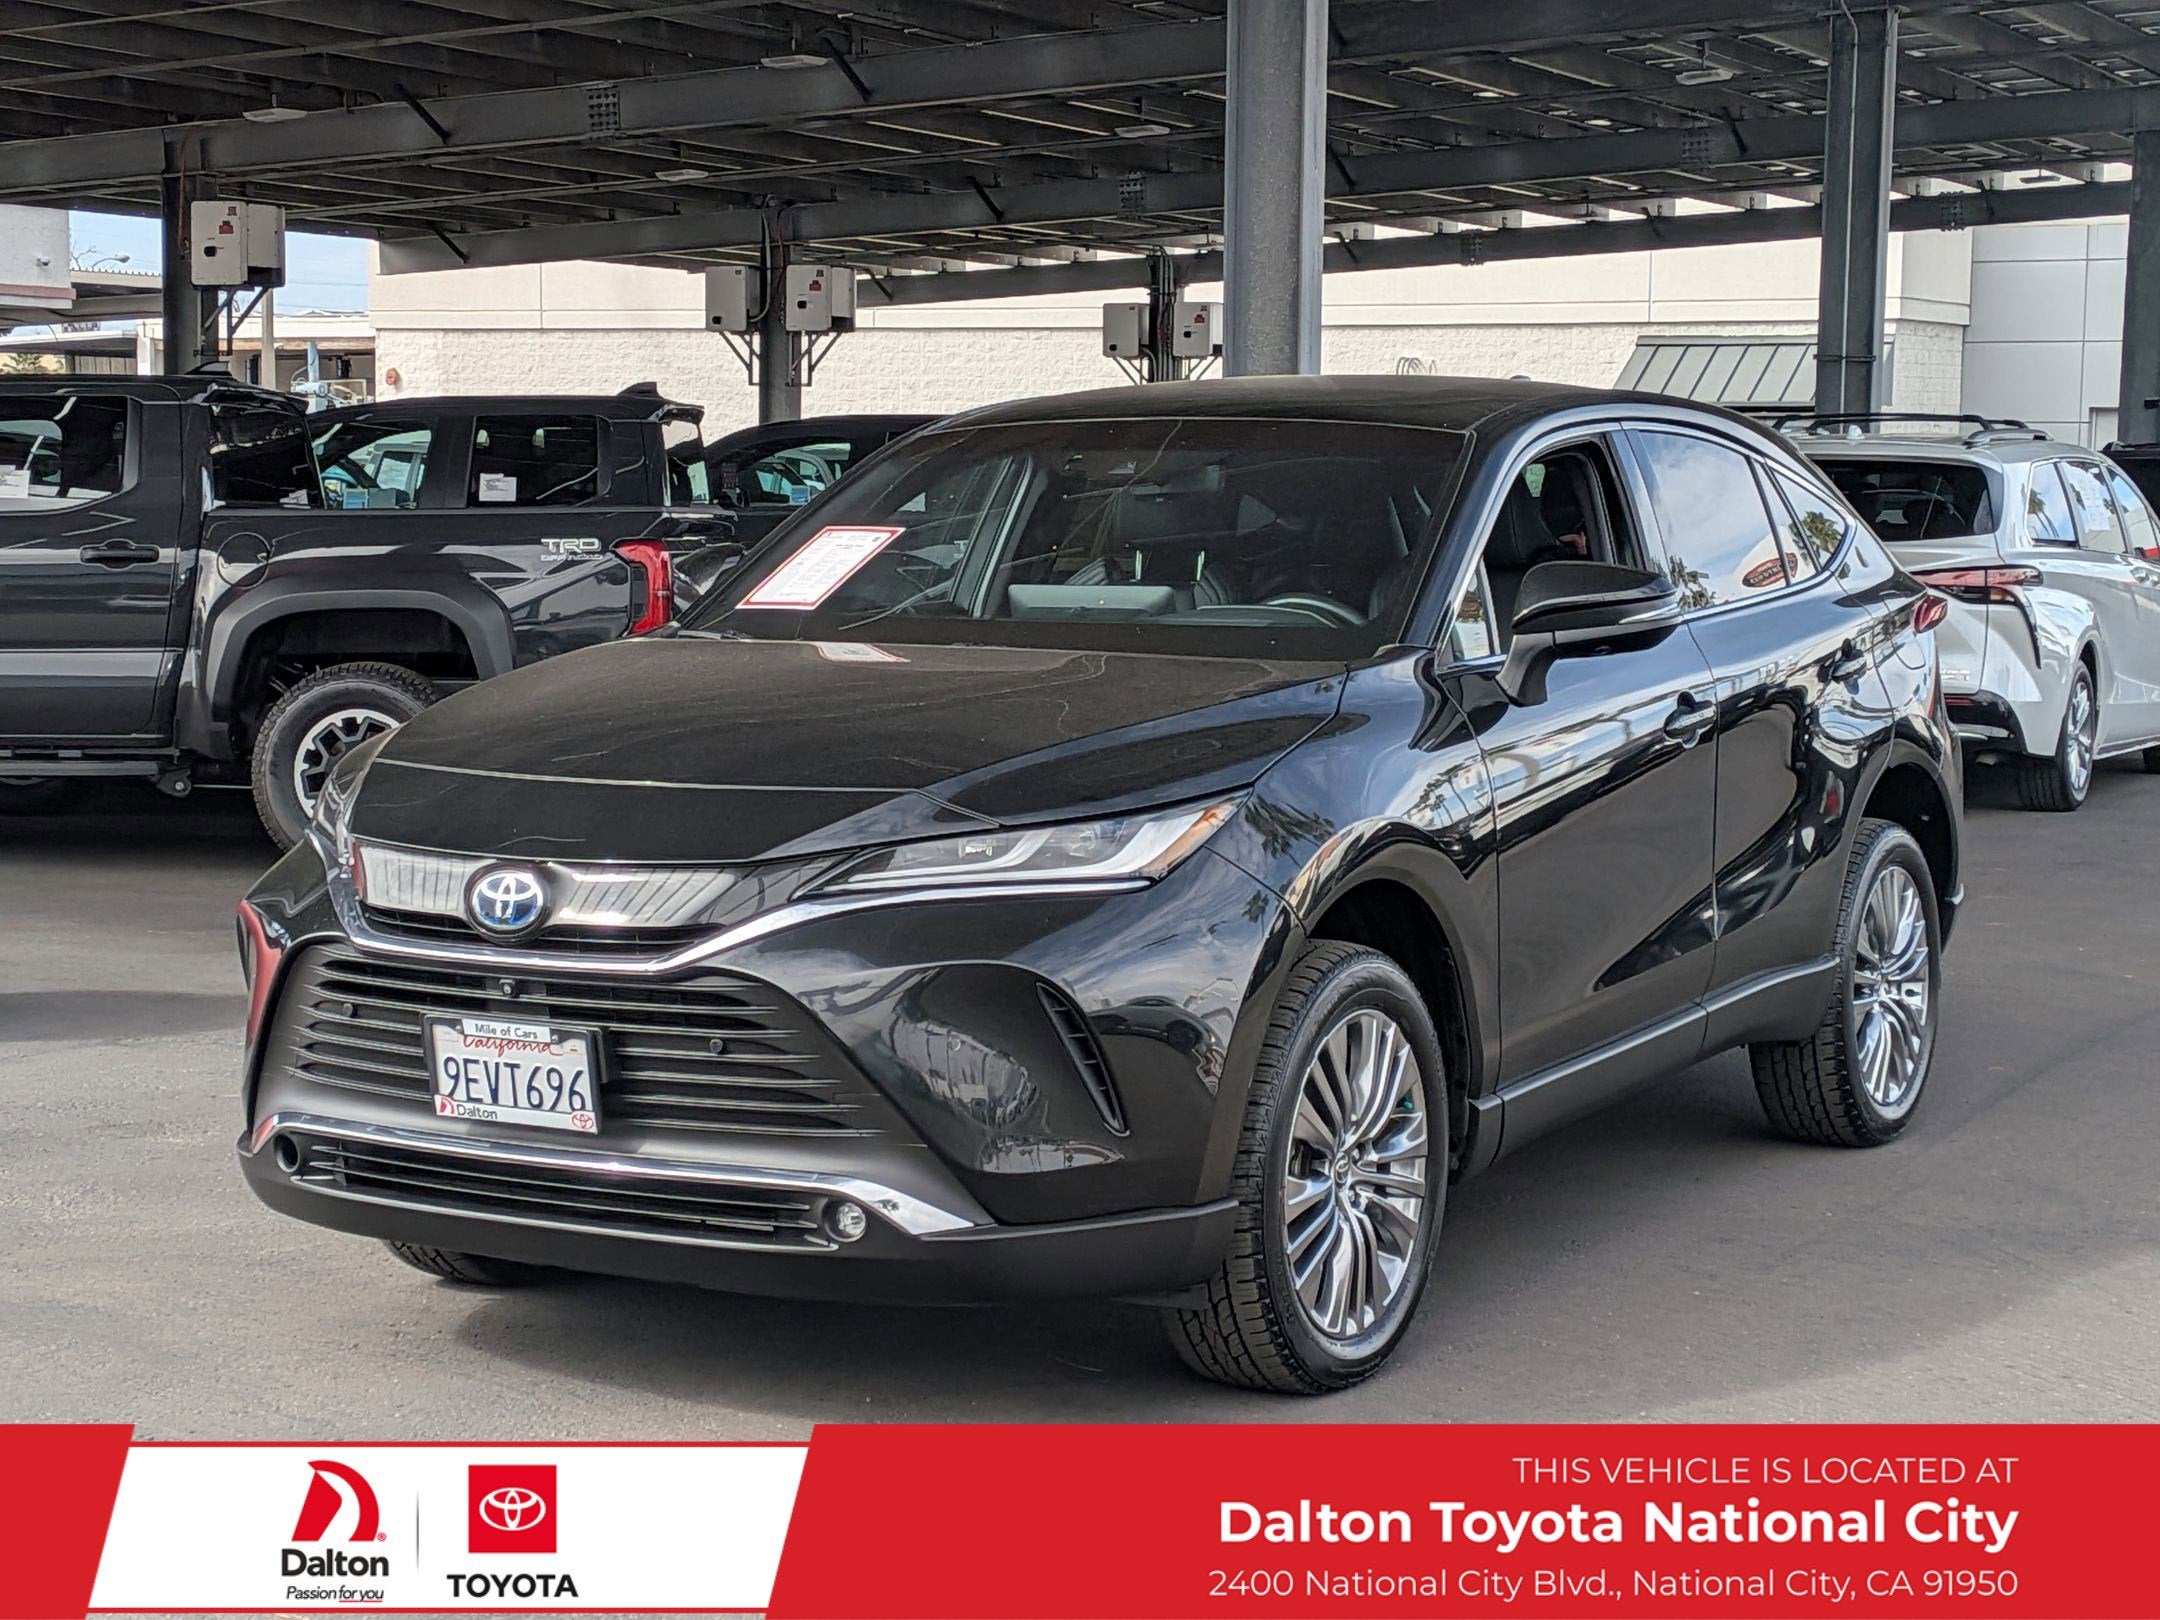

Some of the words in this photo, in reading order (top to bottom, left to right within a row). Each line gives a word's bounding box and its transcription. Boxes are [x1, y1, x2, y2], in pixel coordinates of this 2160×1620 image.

[540, 537, 602, 554] TRD
[474, 1023, 497, 1036] Mile
[500, 1026, 512, 1037] of
[514, 1027, 538, 1040] Cars
[443, 1055, 587, 1113] 9EVT696
[456, 1103, 498, 1120] Dalton
